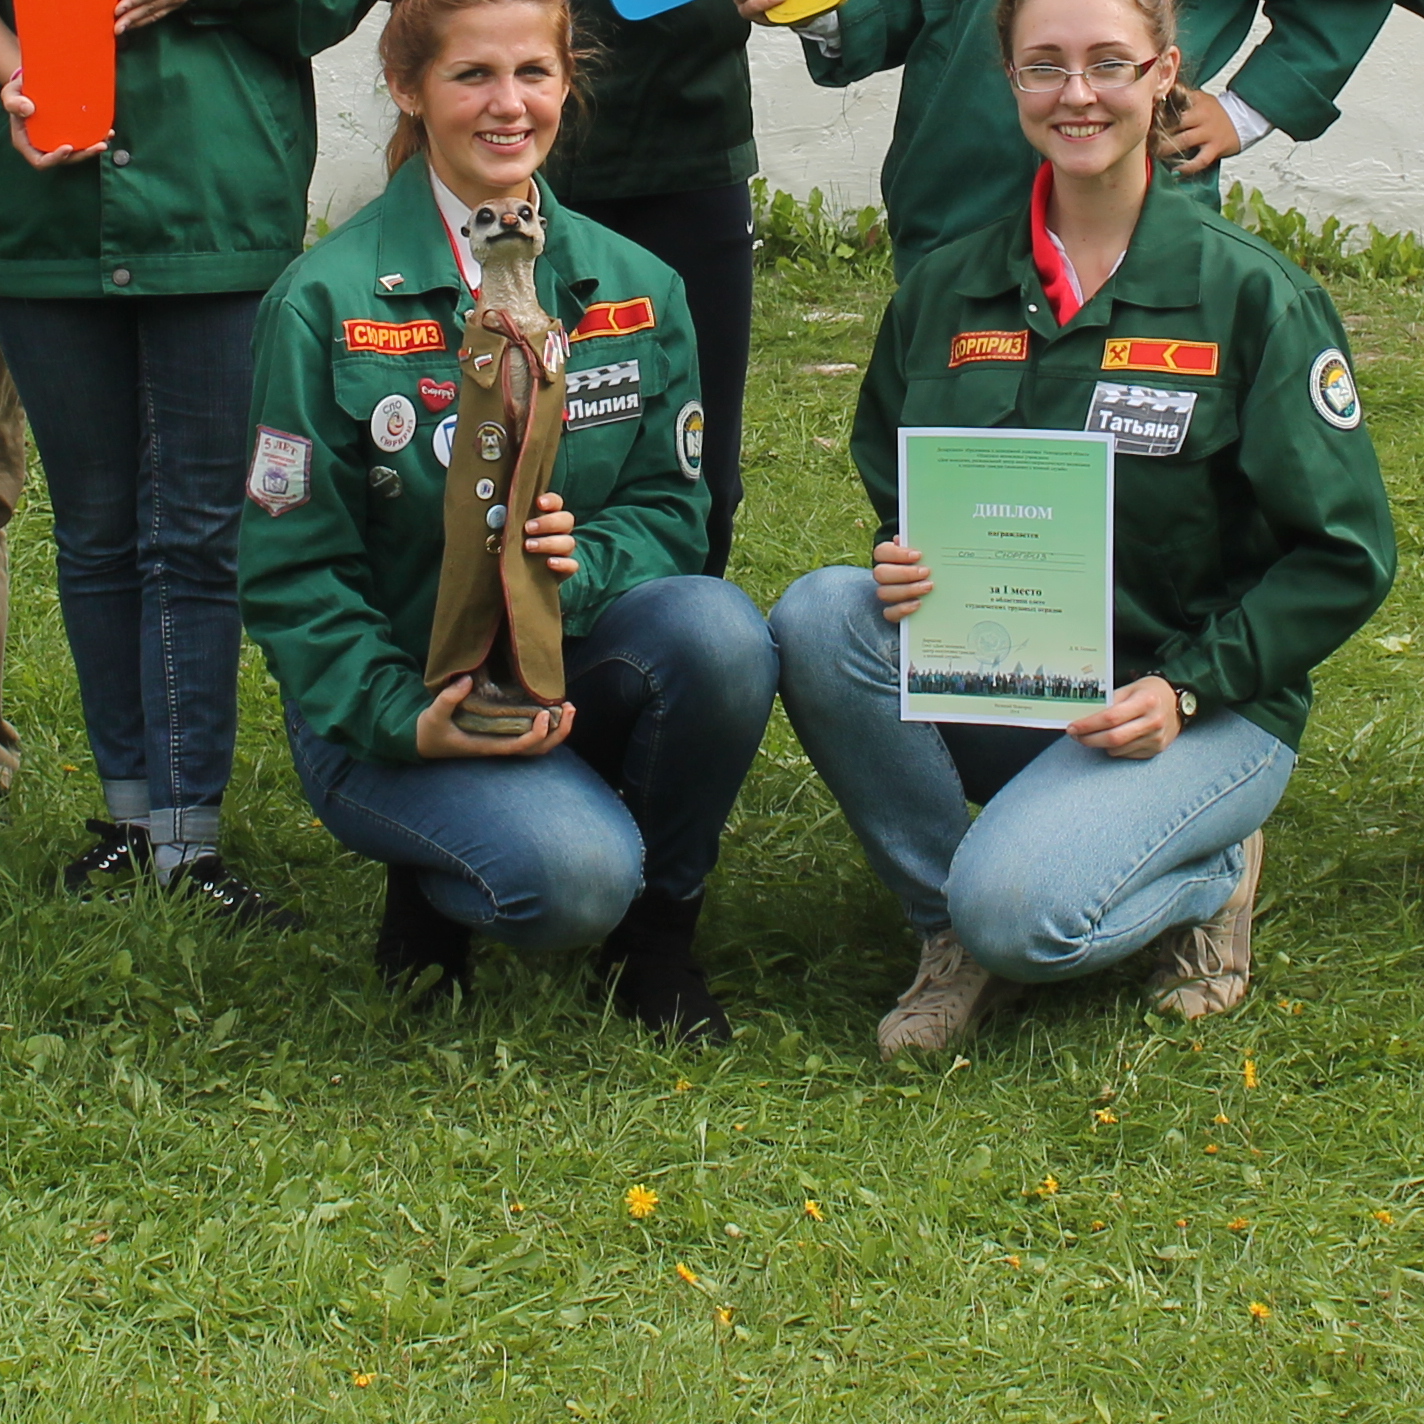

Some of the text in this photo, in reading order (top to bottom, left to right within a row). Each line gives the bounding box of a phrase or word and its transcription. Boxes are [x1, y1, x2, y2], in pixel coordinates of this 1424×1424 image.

[353, 326, 440, 349] СЮРПРИЗ
[382, 400, 402, 415] СПО
[568, 391, 639, 421] Лилия
[380, 419, 414, 447] СЮРПРИЗ
[1098, 408, 1180, 441] Татьяна
[264, 438, 298, 456] 5 ЛЕТ
[972, 503, 1053, 520] ДИПЛОМ
[989, 586, 1000, 594] за
[1011, 587, 1042, 596] место
